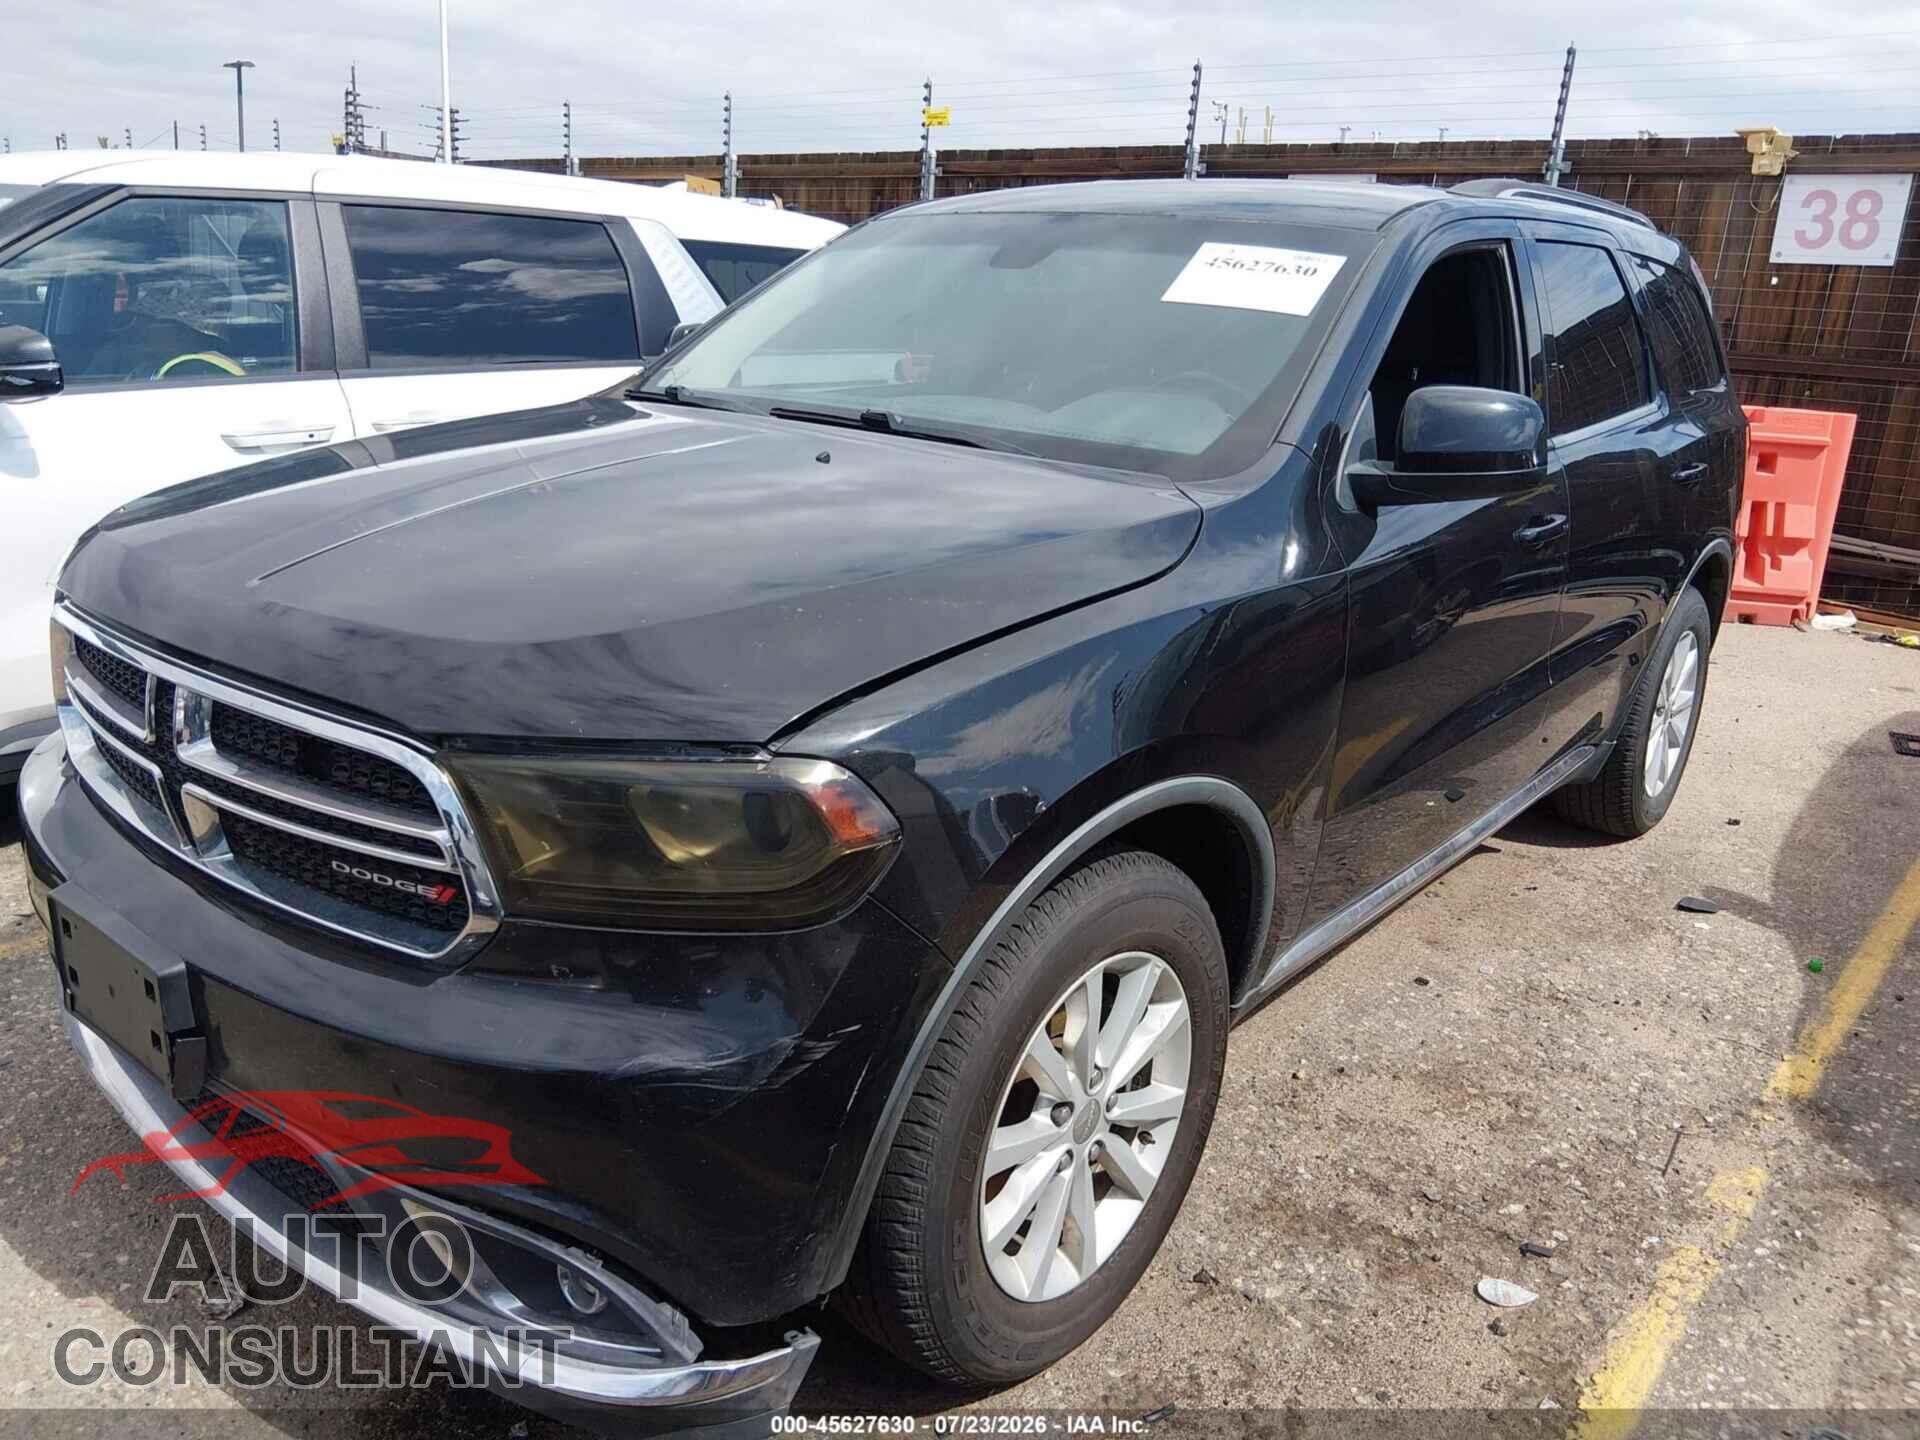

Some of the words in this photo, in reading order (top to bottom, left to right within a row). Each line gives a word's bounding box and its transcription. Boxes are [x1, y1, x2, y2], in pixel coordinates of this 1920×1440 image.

[1793, 188, 1884, 251] 38
[1203, 255, 1319, 278] 45627630
[331, 860, 440, 899] DODGE
